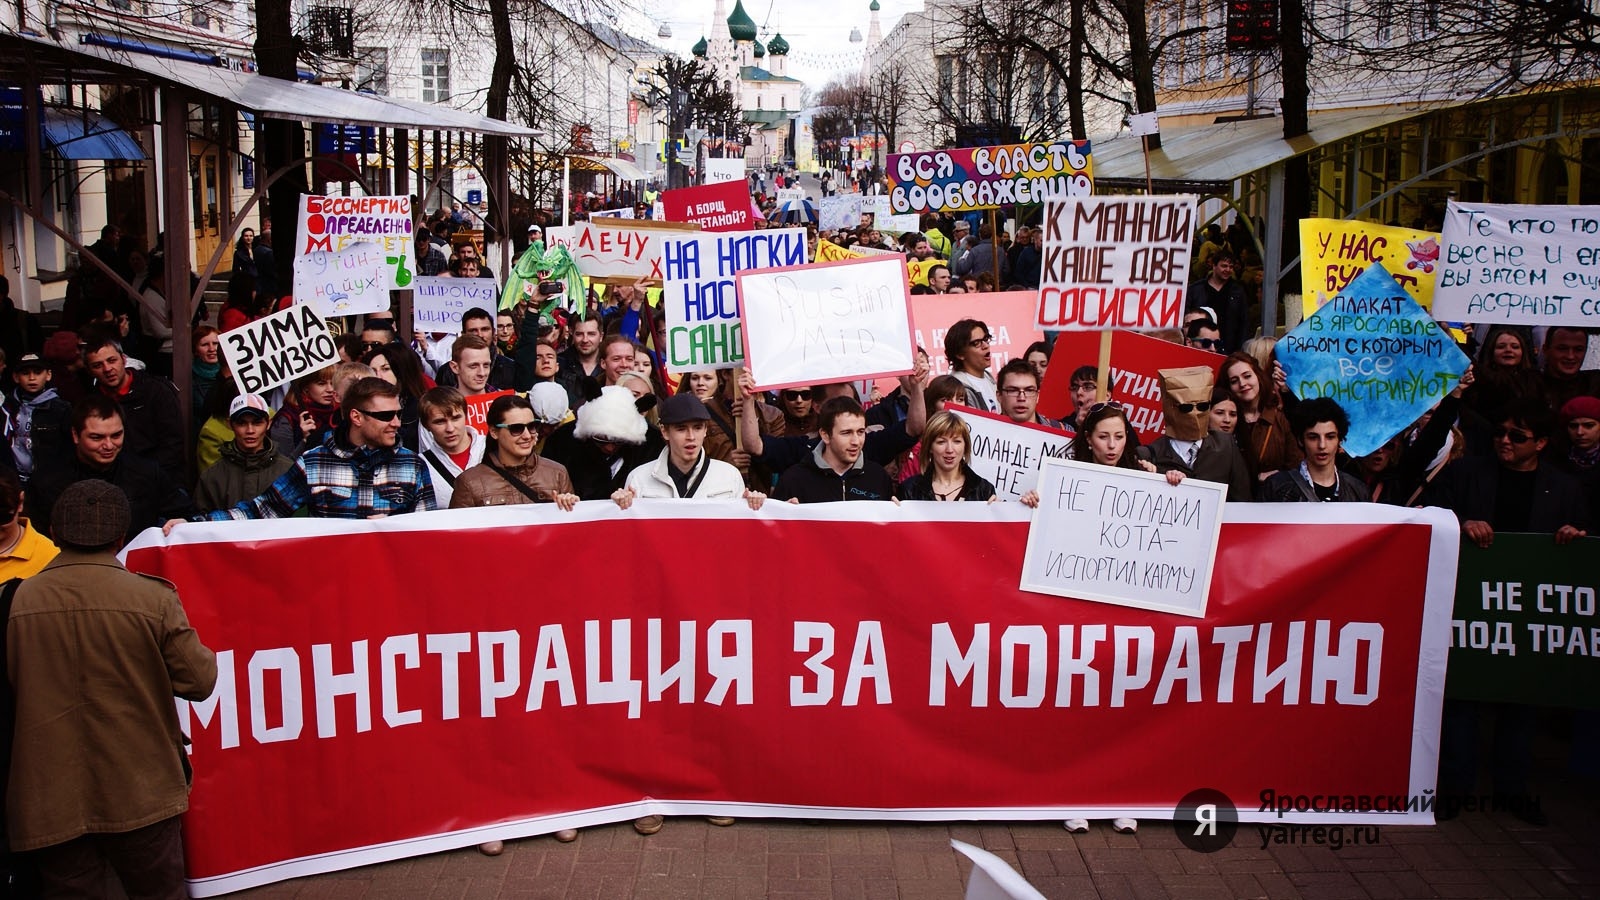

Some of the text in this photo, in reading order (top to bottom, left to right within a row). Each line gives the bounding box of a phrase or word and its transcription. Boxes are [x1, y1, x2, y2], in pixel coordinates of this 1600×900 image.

[897, 142, 1088, 182] ВСЯ ВЛАСТЬ
[686, 200, 726, 217] А БОРЩ
[891, 175, 1092, 213] ВООБРАЖЕНИЮ
[1046, 201, 1191, 243] К МАННОЙ
[1457, 209, 1493, 236] Те
[304, 233, 412, 255] МЕЕТ
[578, 227, 663, 279] ЛЕЧУ Х
[664, 233, 806, 281] НА НОСКИ
[1318, 231, 1388, 263] У НАС
[1044, 246, 1187, 285] КАШЕ ДВЕ
[1326, 264, 1418, 292] БУТ
[1563, 272, 1600, 290] ещ
[418, 309, 463, 323] ШИРО
[684, 280, 739, 322] НОС
[1038, 287, 1183, 329] СОСИСКИ
[1333, 296, 1407, 315] ПЛАКАТ
[228, 305, 326, 366] ЗИМА
[1309, 315, 1324, 333] В
[237, 334, 335, 392] БЛИЗКО
[668, 323, 743, 366] САНД
[1287, 336, 1340, 354] РЯДОМ
[1362, 337, 1443, 357] КОТОРЫМ
[1109, 366, 1162, 402] УТИН
[1299, 369, 1459, 405] МОНСТРИРУЮТ
[995, 466, 1025, 496] НЕ
[1058, 476, 1201, 530] НЕ ПОГЛАДИЛ
[1045, 550, 1196, 594] ИСПОРТИЛ КАРМУ
[1481, 581, 1522, 612] НЕ
[1451, 619, 1516, 656] ПОД
[176, 618, 1386, 755] МОНСТРАЦИЯ ЗА МОКРАТИЮ
